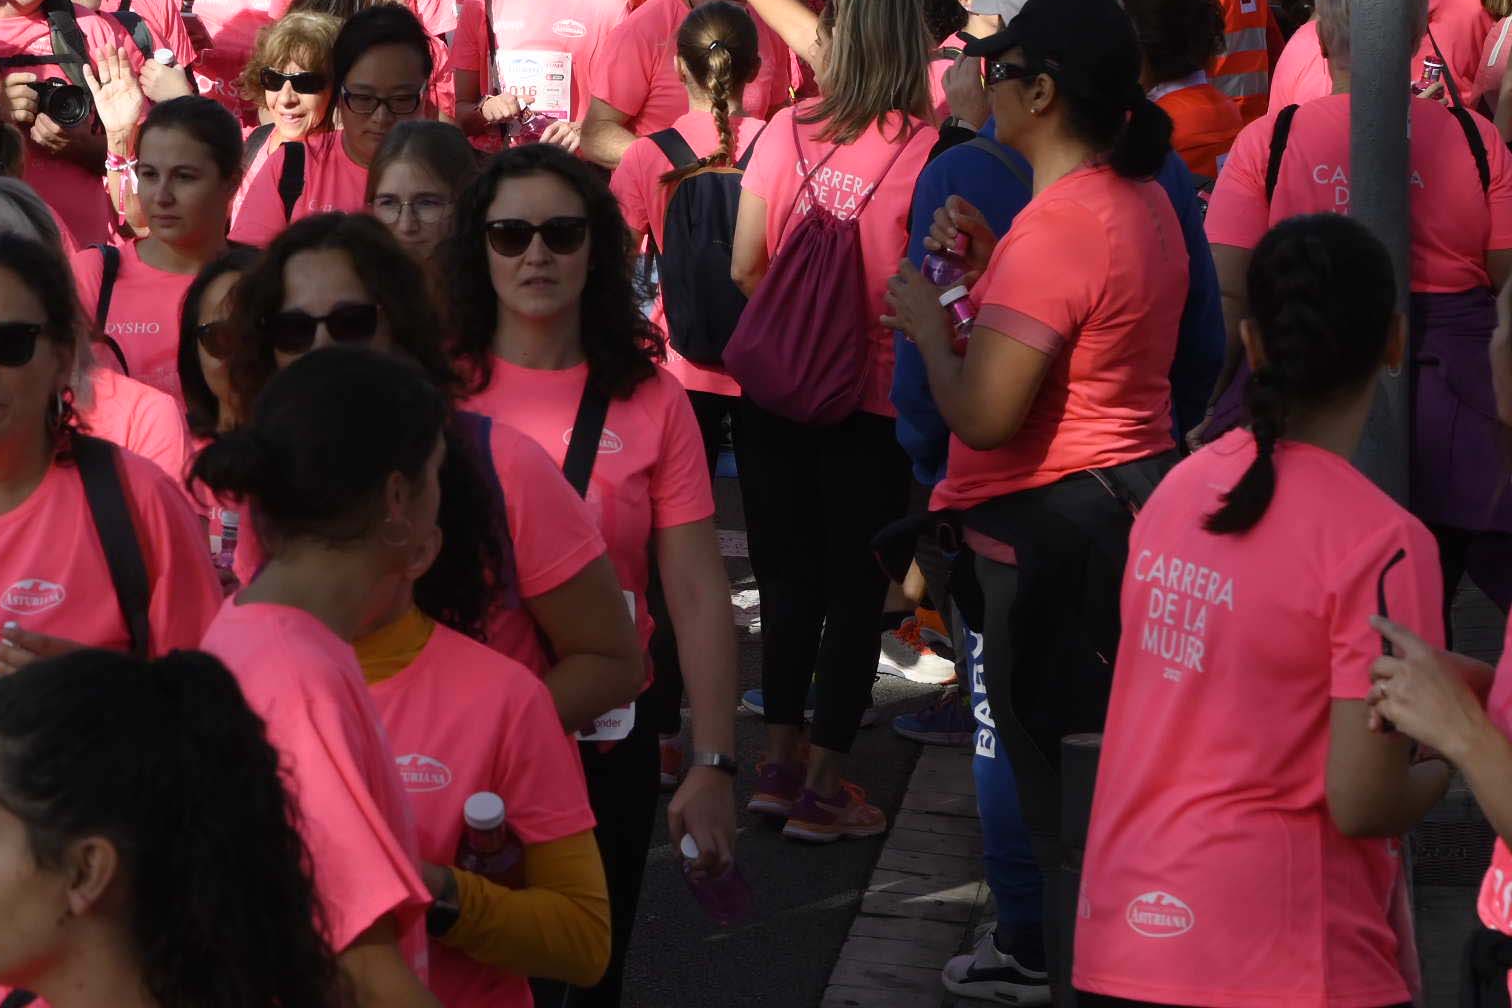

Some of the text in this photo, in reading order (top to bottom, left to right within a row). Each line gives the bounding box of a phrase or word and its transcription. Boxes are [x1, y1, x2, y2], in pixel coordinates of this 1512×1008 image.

[795, 158, 876, 200] CARRERA
[834, 191, 857, 210] LA
[1134, 549, 1234, 612] CARRERA
[1148, 587, 1209, 637] DE LA
[1141, 621, 1206, 673] MUJER
